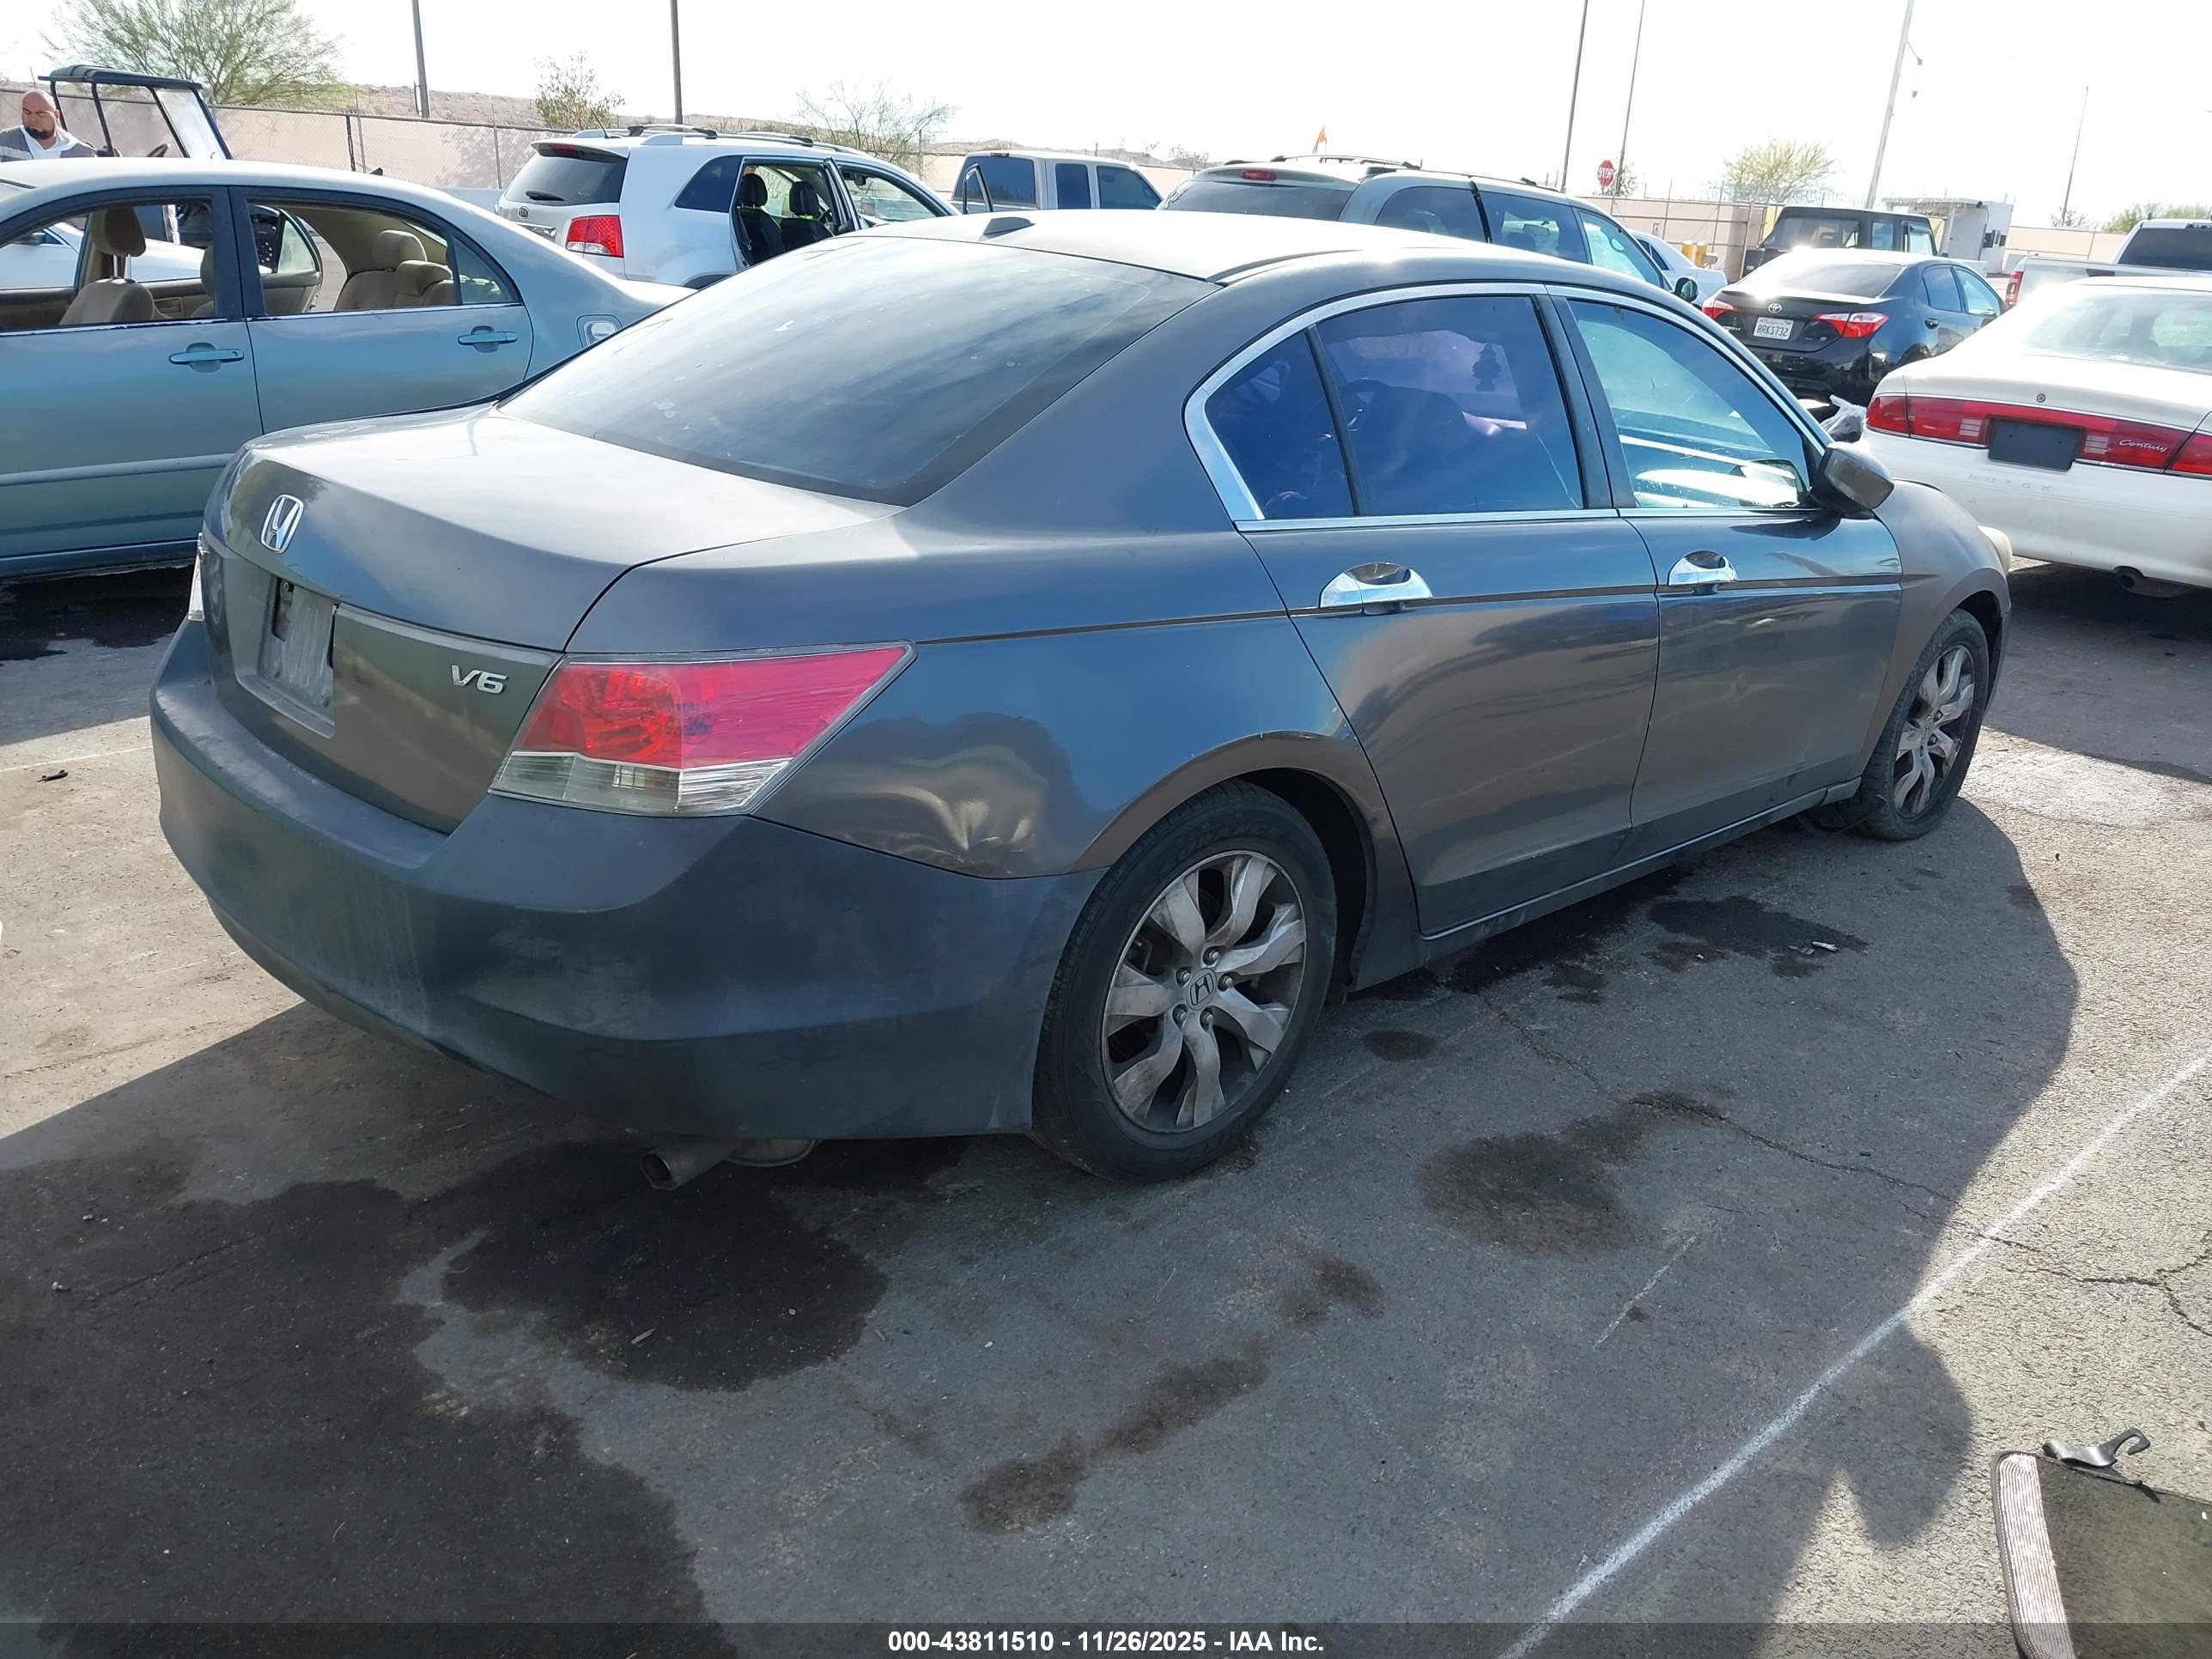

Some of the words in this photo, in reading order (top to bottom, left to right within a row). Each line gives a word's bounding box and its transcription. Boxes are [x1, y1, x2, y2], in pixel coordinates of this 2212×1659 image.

[1598, 167, 1613, 179] STOP
[2119, 439, 2169, 453] Century
[1966, 474, 2053, 492] BUICK
[451, 665, 509, 694] V6
